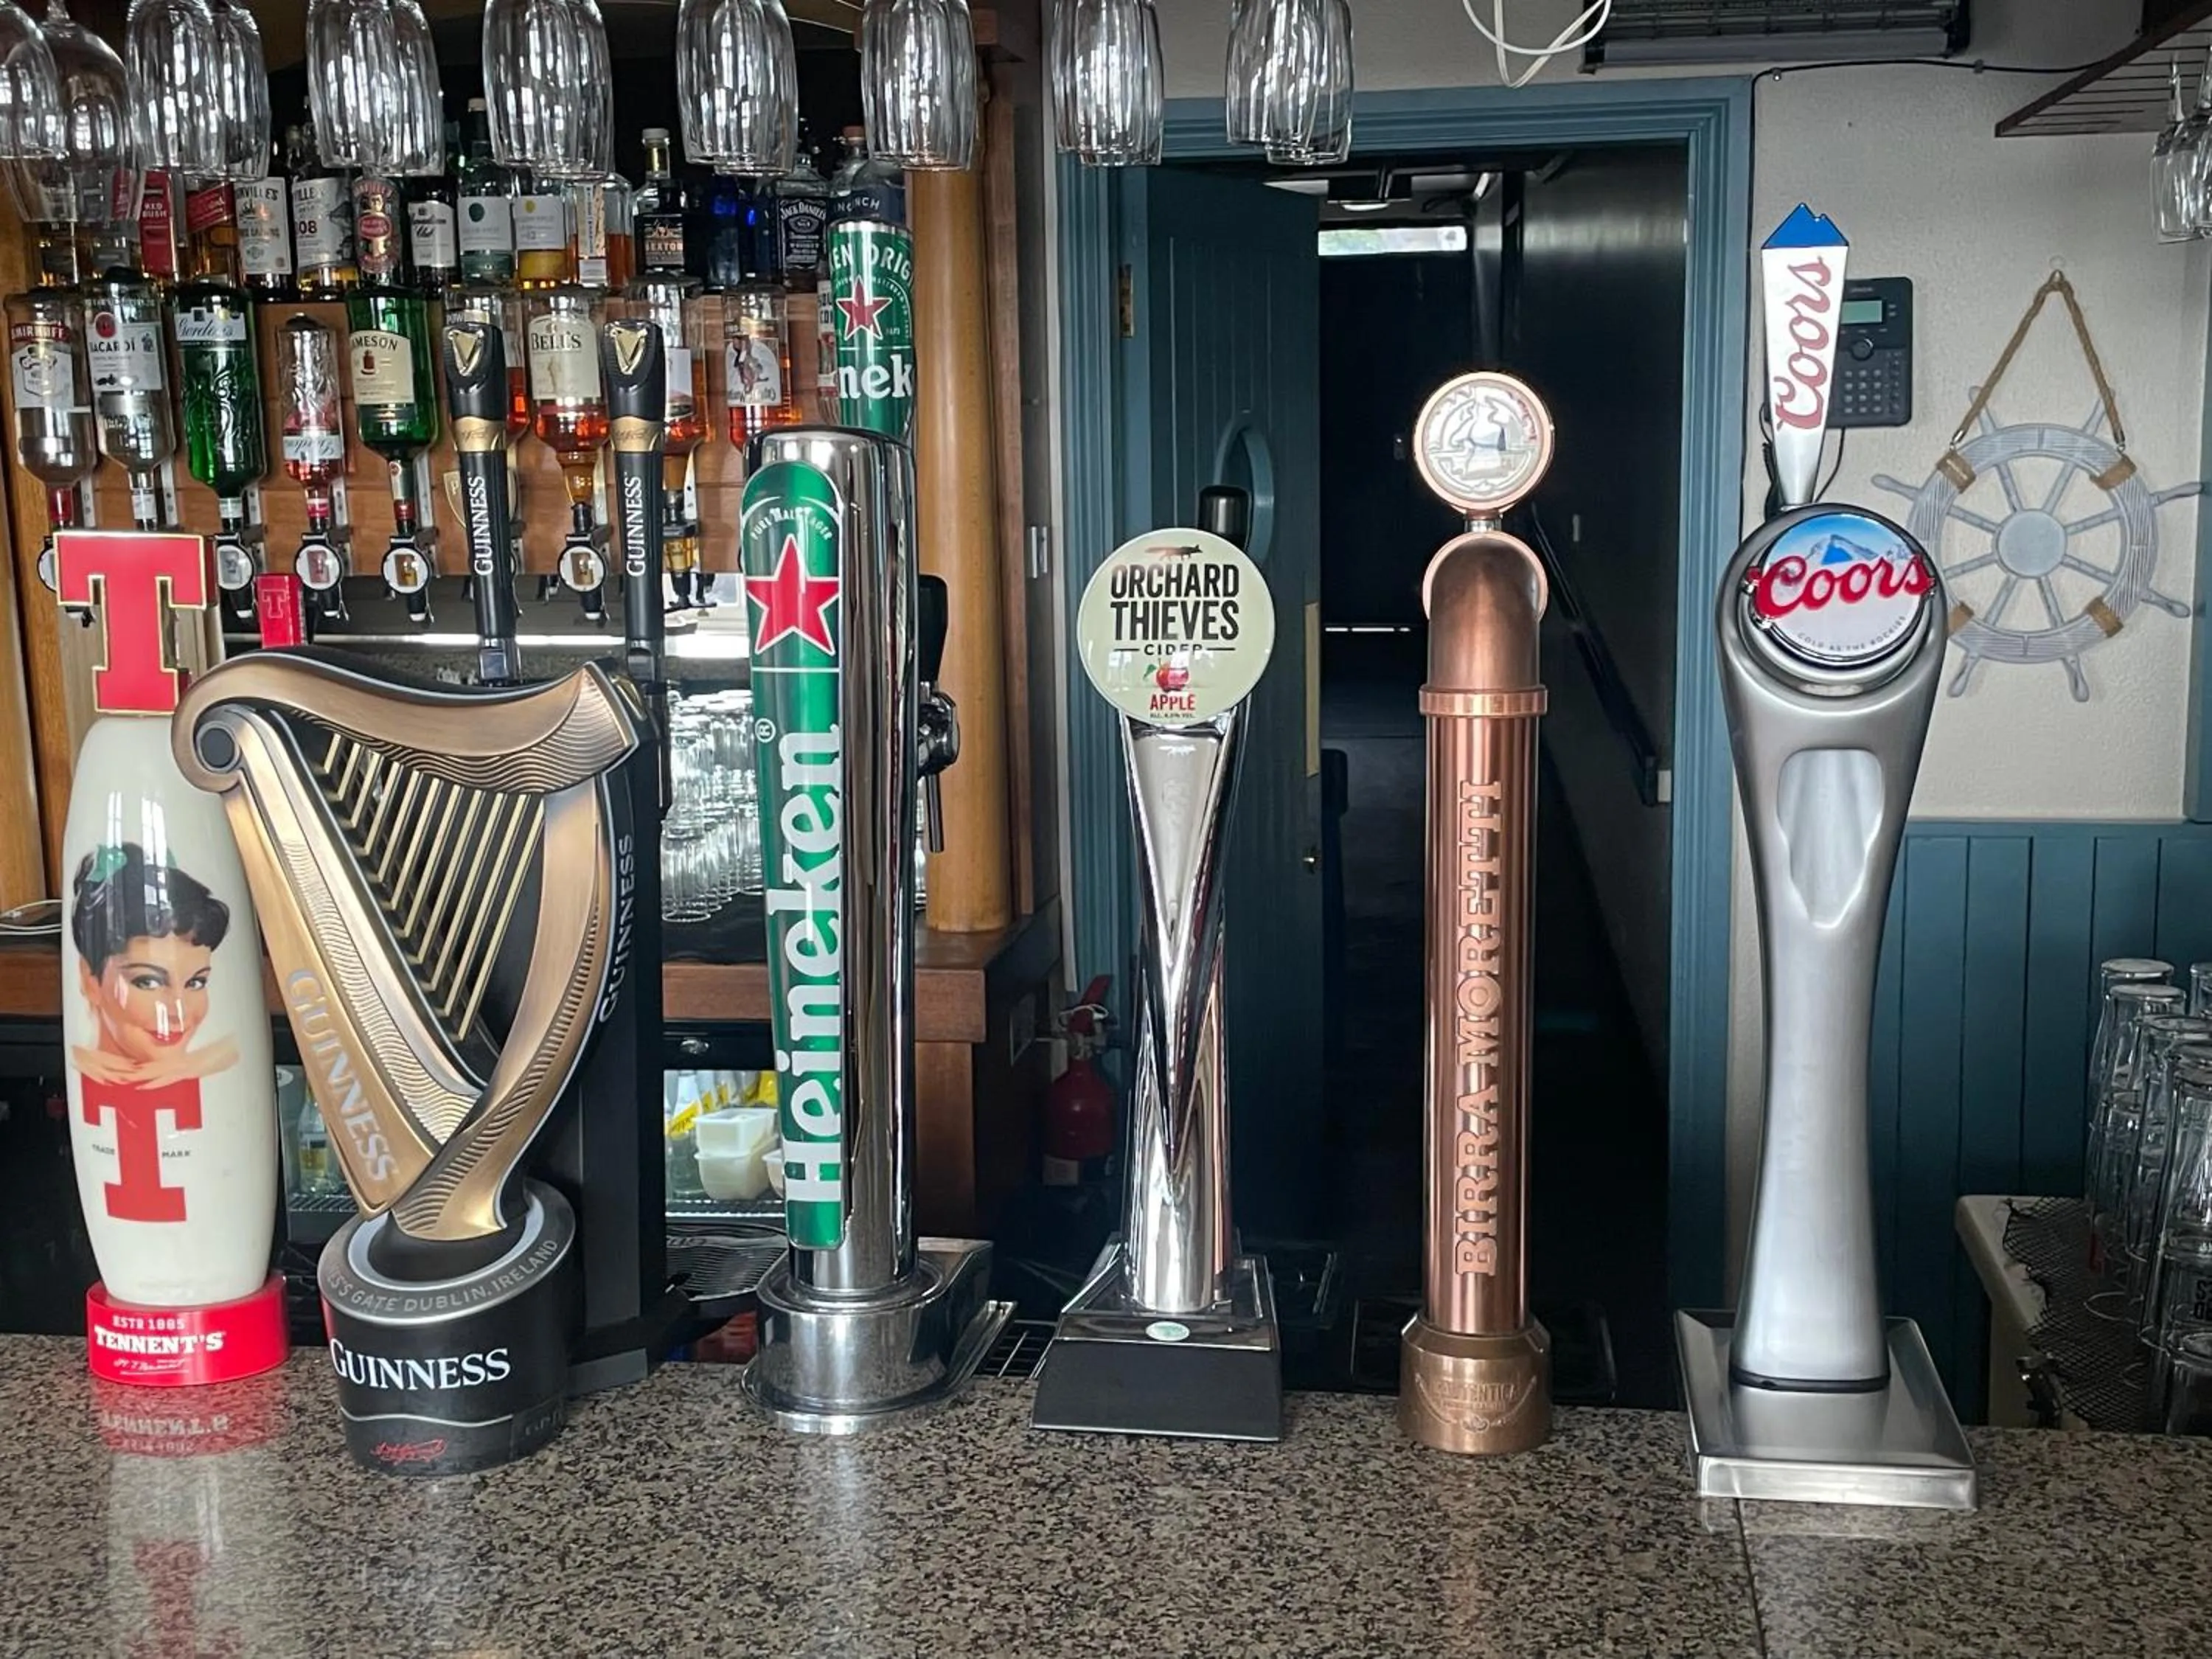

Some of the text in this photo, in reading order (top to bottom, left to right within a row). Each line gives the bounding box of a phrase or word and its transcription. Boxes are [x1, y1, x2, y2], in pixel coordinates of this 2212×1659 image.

[353, 335, 398, 351] MESON
[1773, 255, 1832, 431] Coors
[467, 475, 493, 575] GUINNESS
[625, 476, 646, 577] GUINNESS
[53, 531, 207, 714] T
[1110, 563, 1239, 598] ORCHARD
[1110, 600, 1239, 640] THIEVES
[1745, 554, 1936, 619] Coors
[1150, 694, 1196, 710] APPLE
[599, 834, 635, 1023] GUINNESS
[767, 723, 841, 1203] Heineken
[1454, 779, 1503, 1276] BIRRA MORETTI
[286, 968, 400, 1181] GUINNESS
[351, 1290, 400, 1312] GATE
[492, 1239, 558, 1292] IRELAND
[94, 1324, 225, 1354] TENNENT'S
[330, 1337, 511, 1391] GUINNESS
